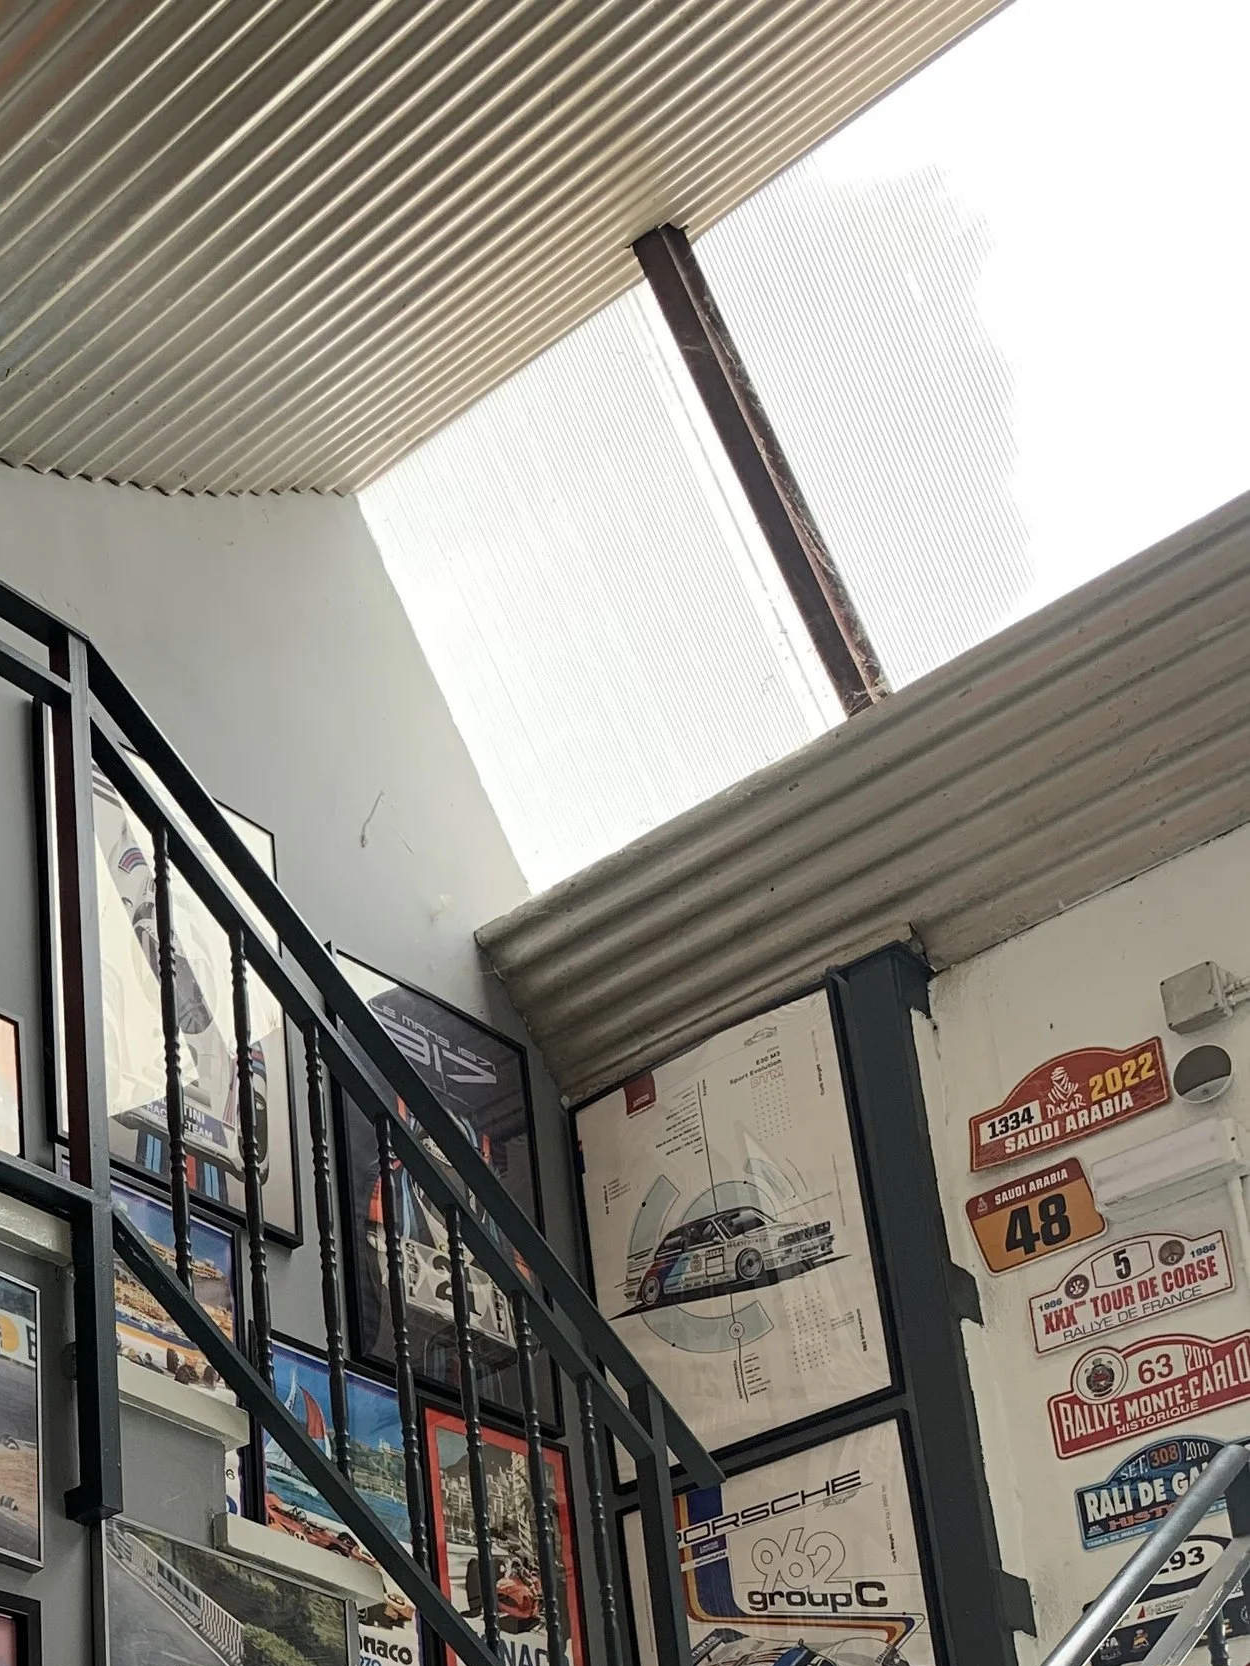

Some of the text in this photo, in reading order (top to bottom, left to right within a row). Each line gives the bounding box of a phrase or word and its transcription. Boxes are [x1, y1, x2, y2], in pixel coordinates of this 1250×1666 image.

[369, 1000, 396, 1019] LE
[987, 1051, 1156, 1140] 1334 DAKAR 2022
[1004, 1090, 1134, 1154] SAUDI ARABIA
[994, 1168, 1068, 1205] SAUDI ARABIA
[1005, 1193, 1071, 1255] 48
[1113, 1248, 1132, 1280] 5
[1190, 1243, 1216, 1258] 1986
[1090, 1255, 1218, 1317] TOUR DE CORSE
[1063, 1285, 1203, 1342] RALLYE DE FRANCE
[1138, 1345, 1213, 1385] 63 2011
[1059, 1342, 1250, 1442] RALLYE MONTE-CARLO
[1116, 1400, 1200, 1435] HISTORIQUE
[1151, 1445, 1177, 1466] 308
[1183, 1441, 1209, 1460] 2010
[1083, 1478, 1166, 1523] RALI DE
[752, 1527, 852, 1594] 962
[359, 1634, 413, 1666] naco
